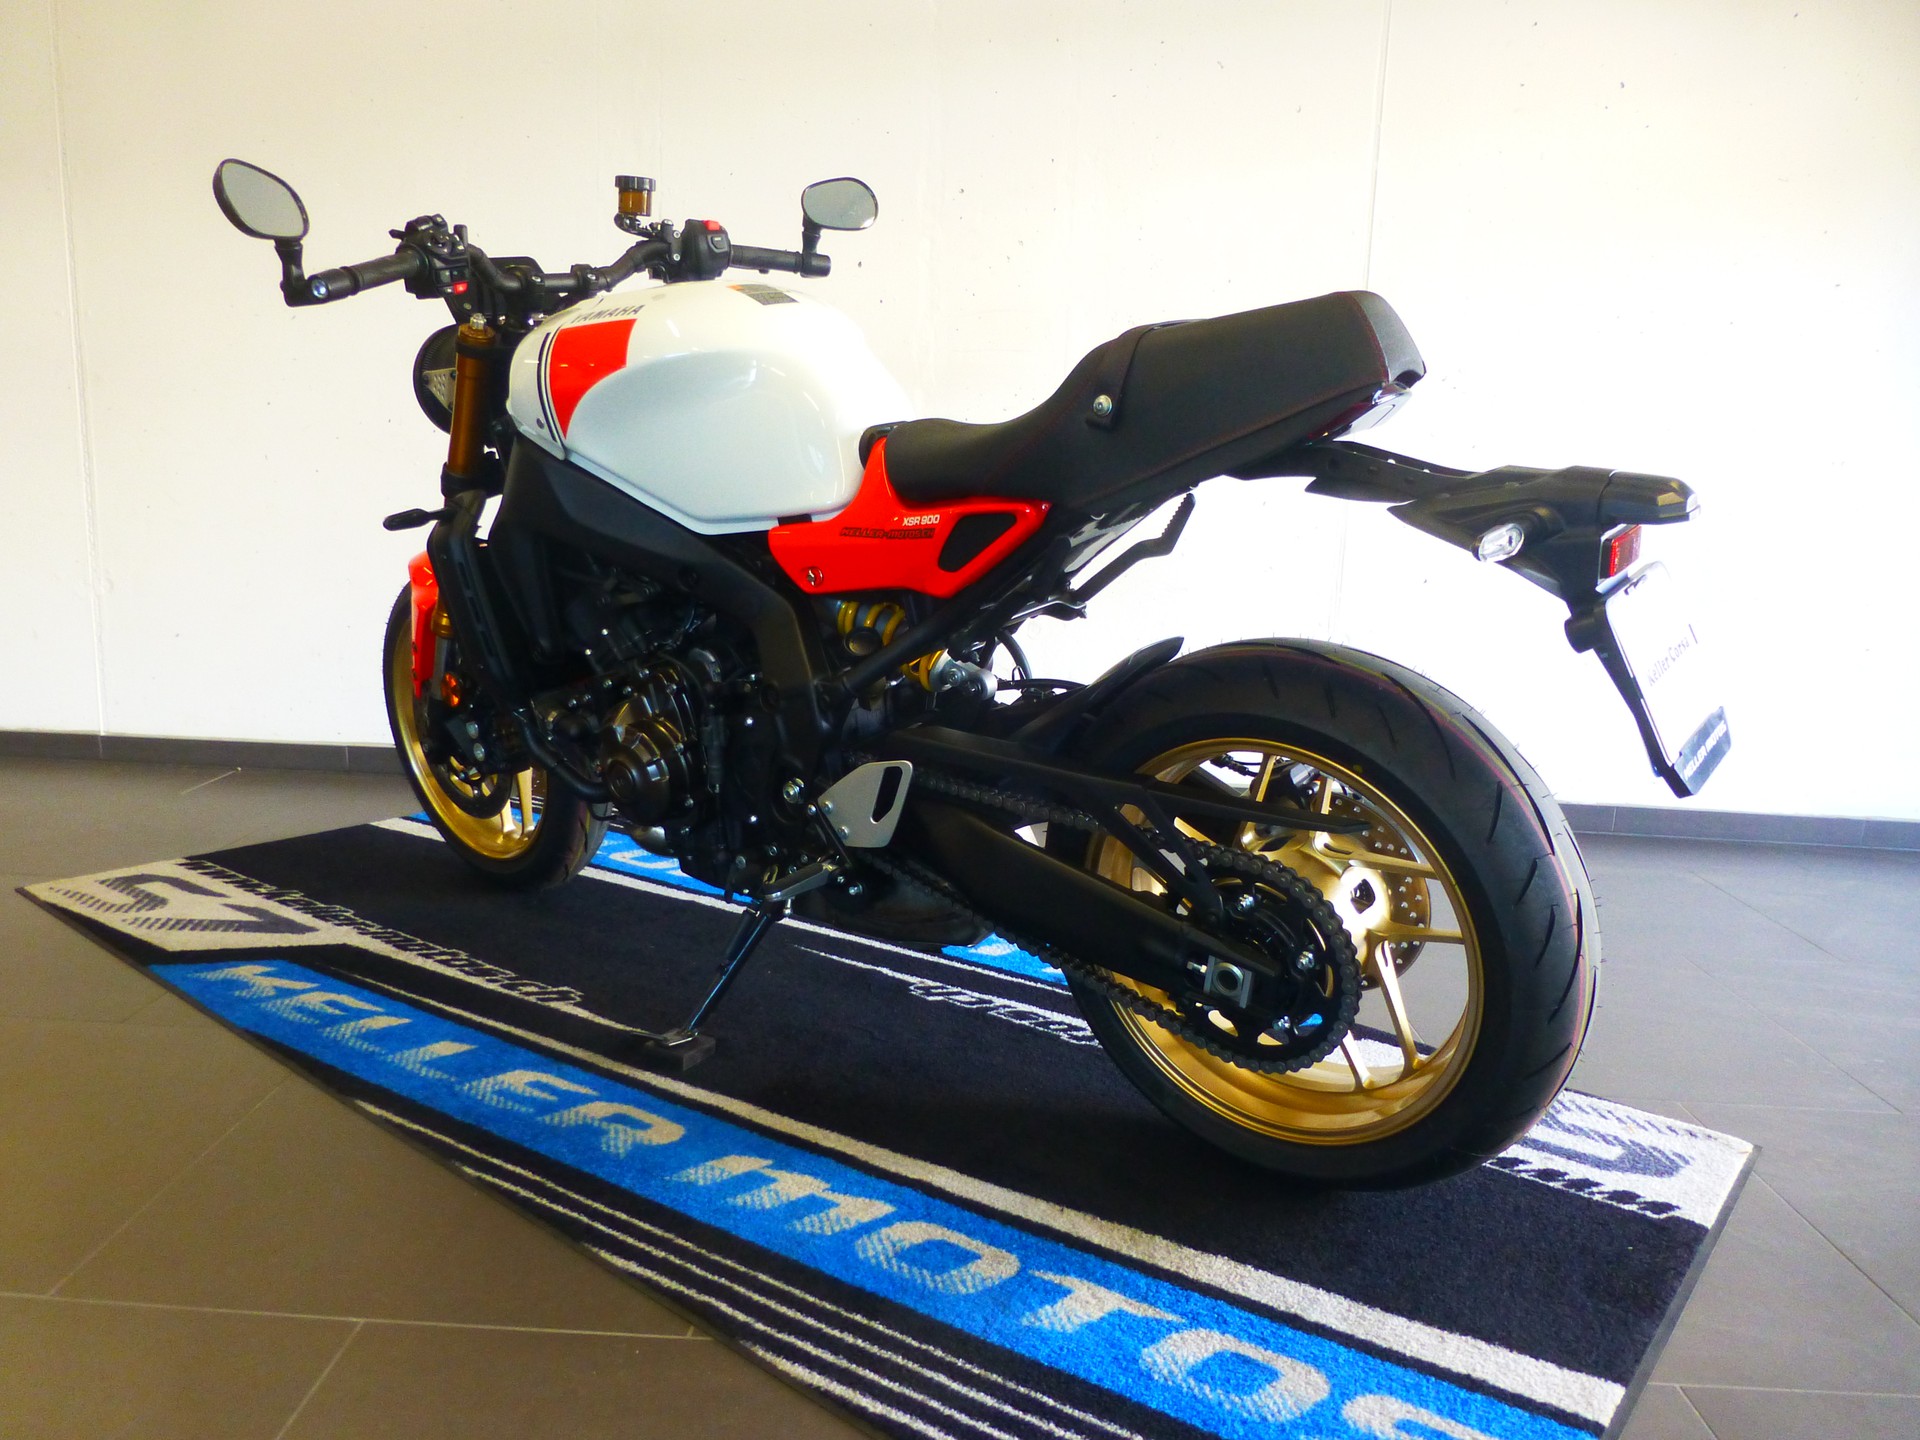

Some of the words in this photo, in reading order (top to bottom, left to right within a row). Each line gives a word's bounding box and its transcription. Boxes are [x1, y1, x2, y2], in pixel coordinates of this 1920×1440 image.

[571, 304, 645, 324] YAMAHA
[902, 516, 920, 526] XSR
[921, 514, 940, 525] 900
[188, 965, 686, 1159] KELLER
